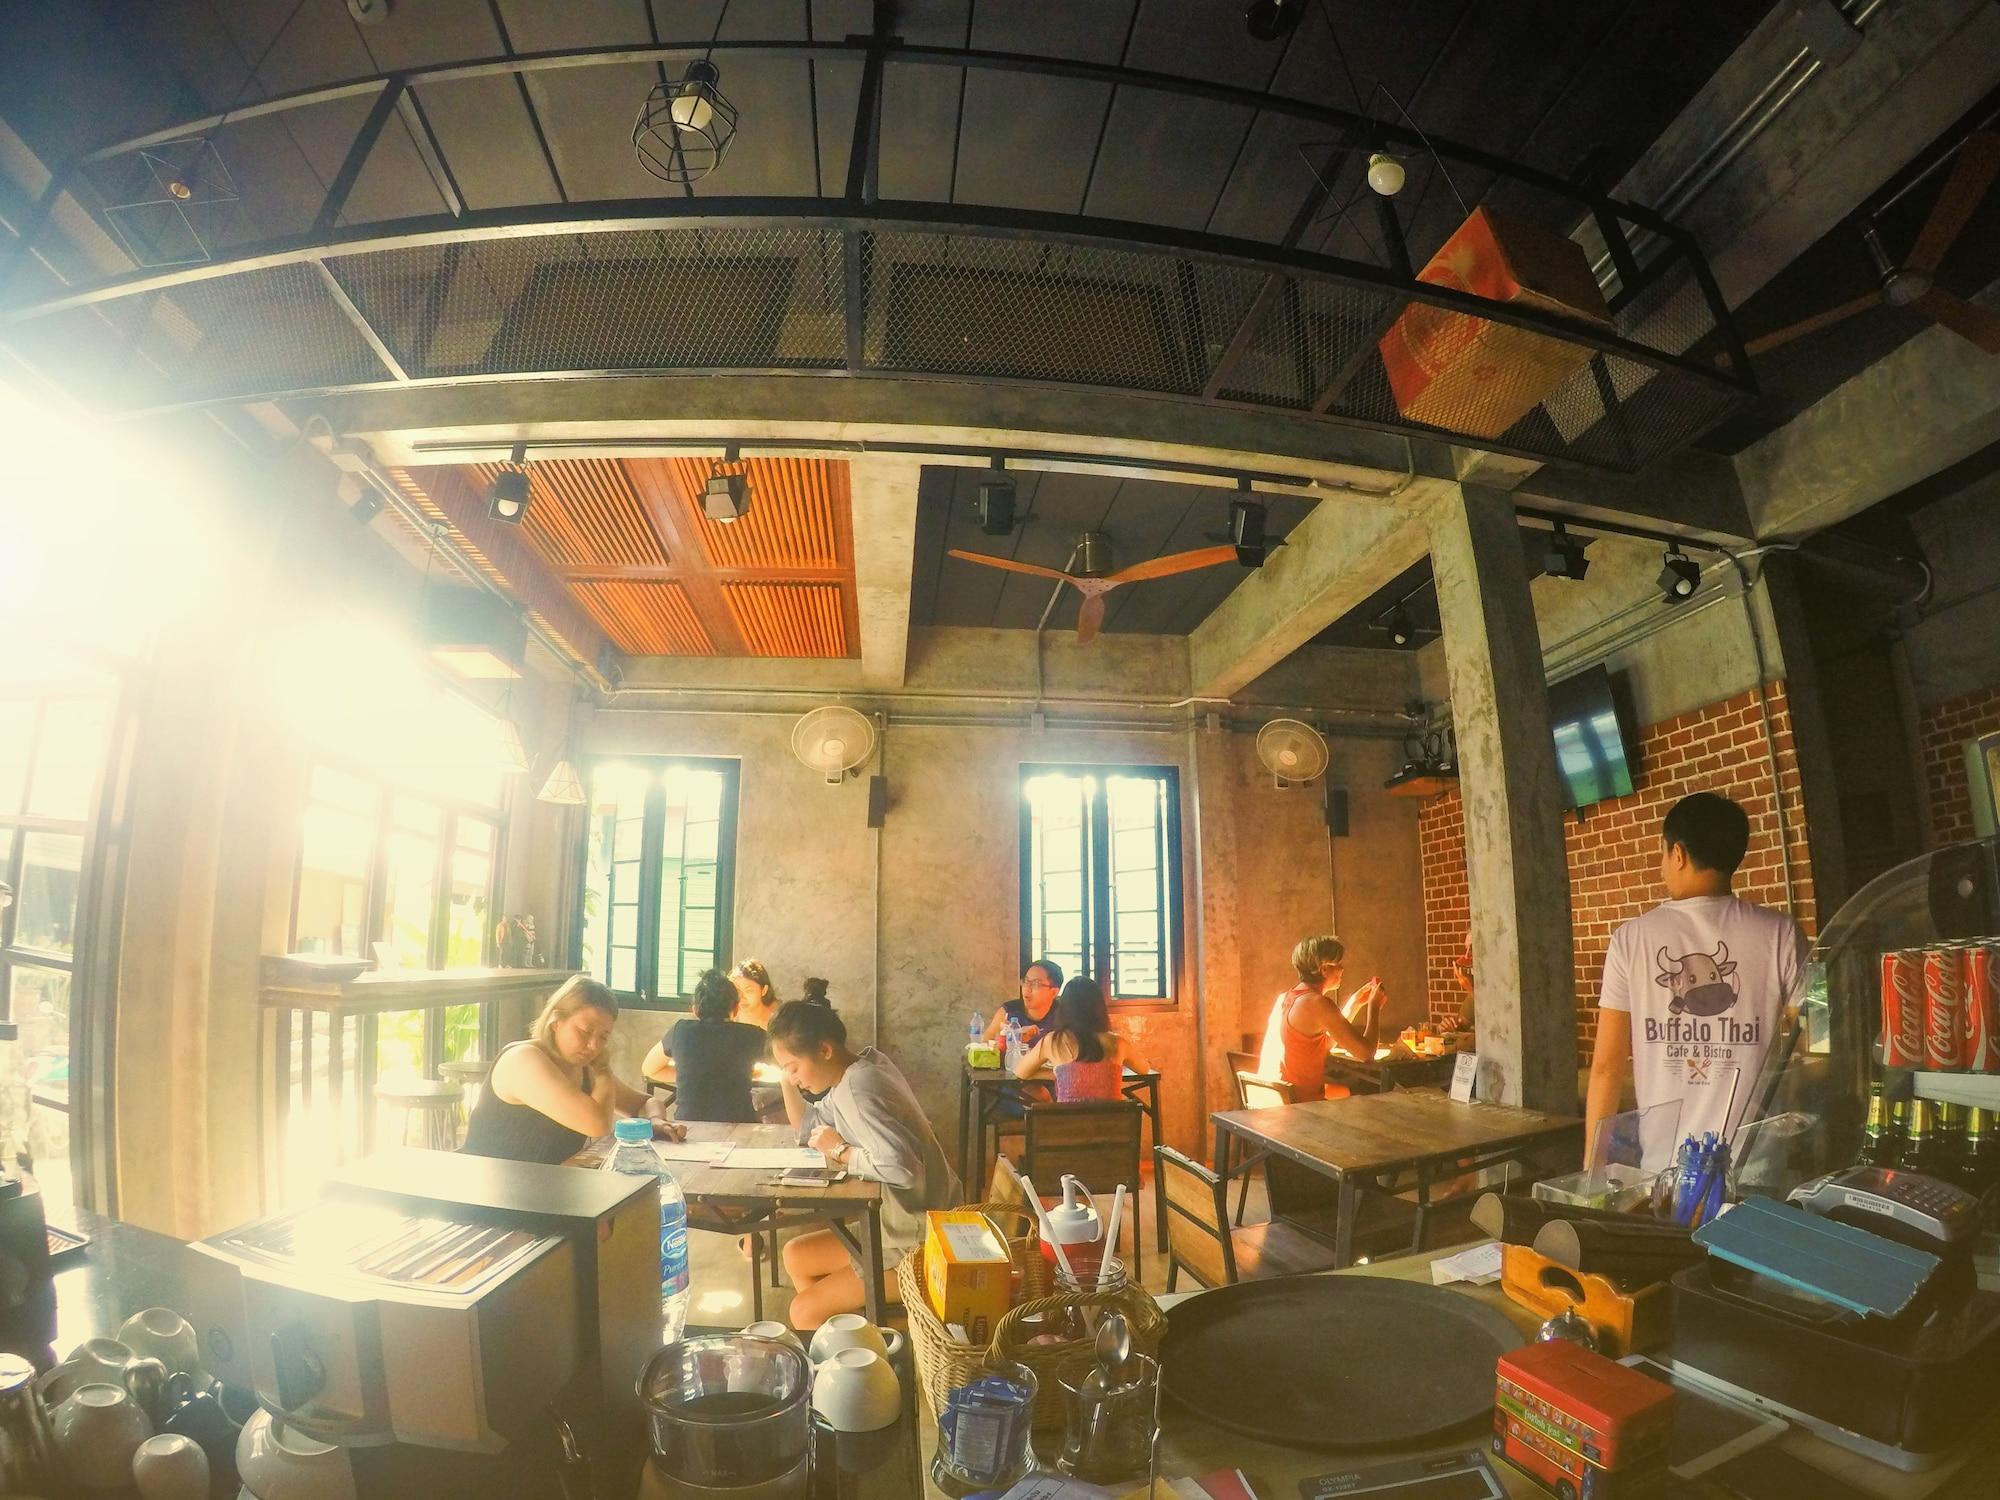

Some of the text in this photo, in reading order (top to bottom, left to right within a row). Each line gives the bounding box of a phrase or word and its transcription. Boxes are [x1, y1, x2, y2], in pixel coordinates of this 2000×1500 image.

[1644, 1016, 1760, 1043] Buffalo Thai
[1666, 1045, 1732, 1059] Cafe & Bistro
